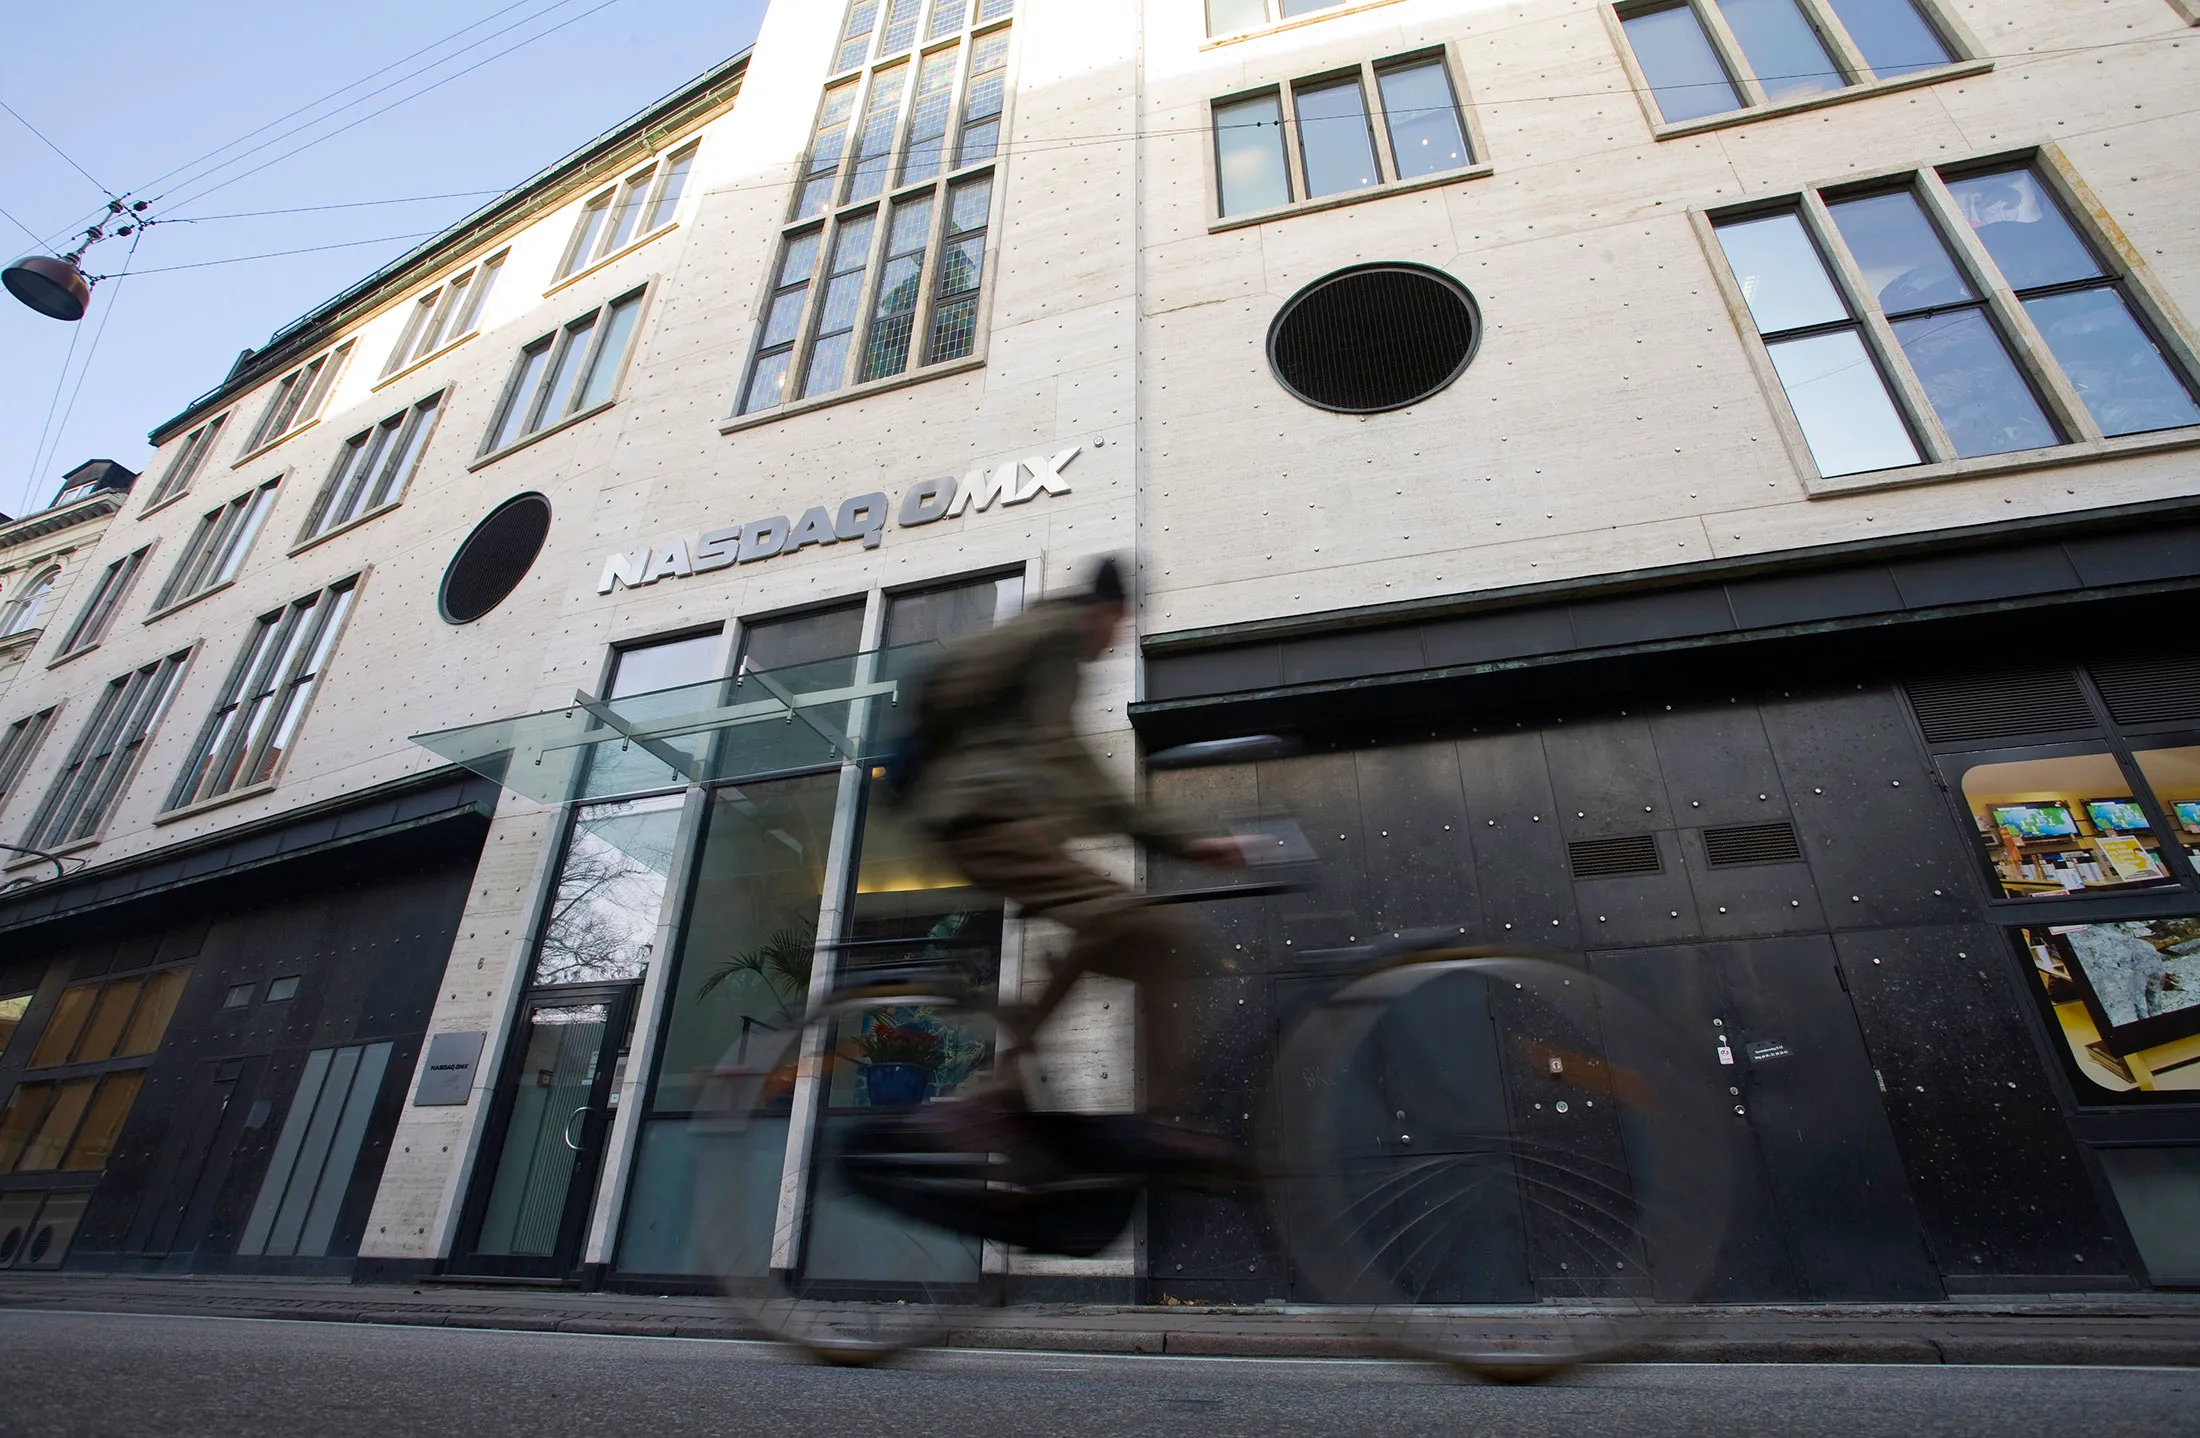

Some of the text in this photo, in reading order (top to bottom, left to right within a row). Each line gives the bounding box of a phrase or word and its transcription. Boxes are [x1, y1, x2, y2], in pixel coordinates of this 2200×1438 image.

[597, 446, 1083, 596] NASDAQ OMX
[477, 957, 485, 970] 6
